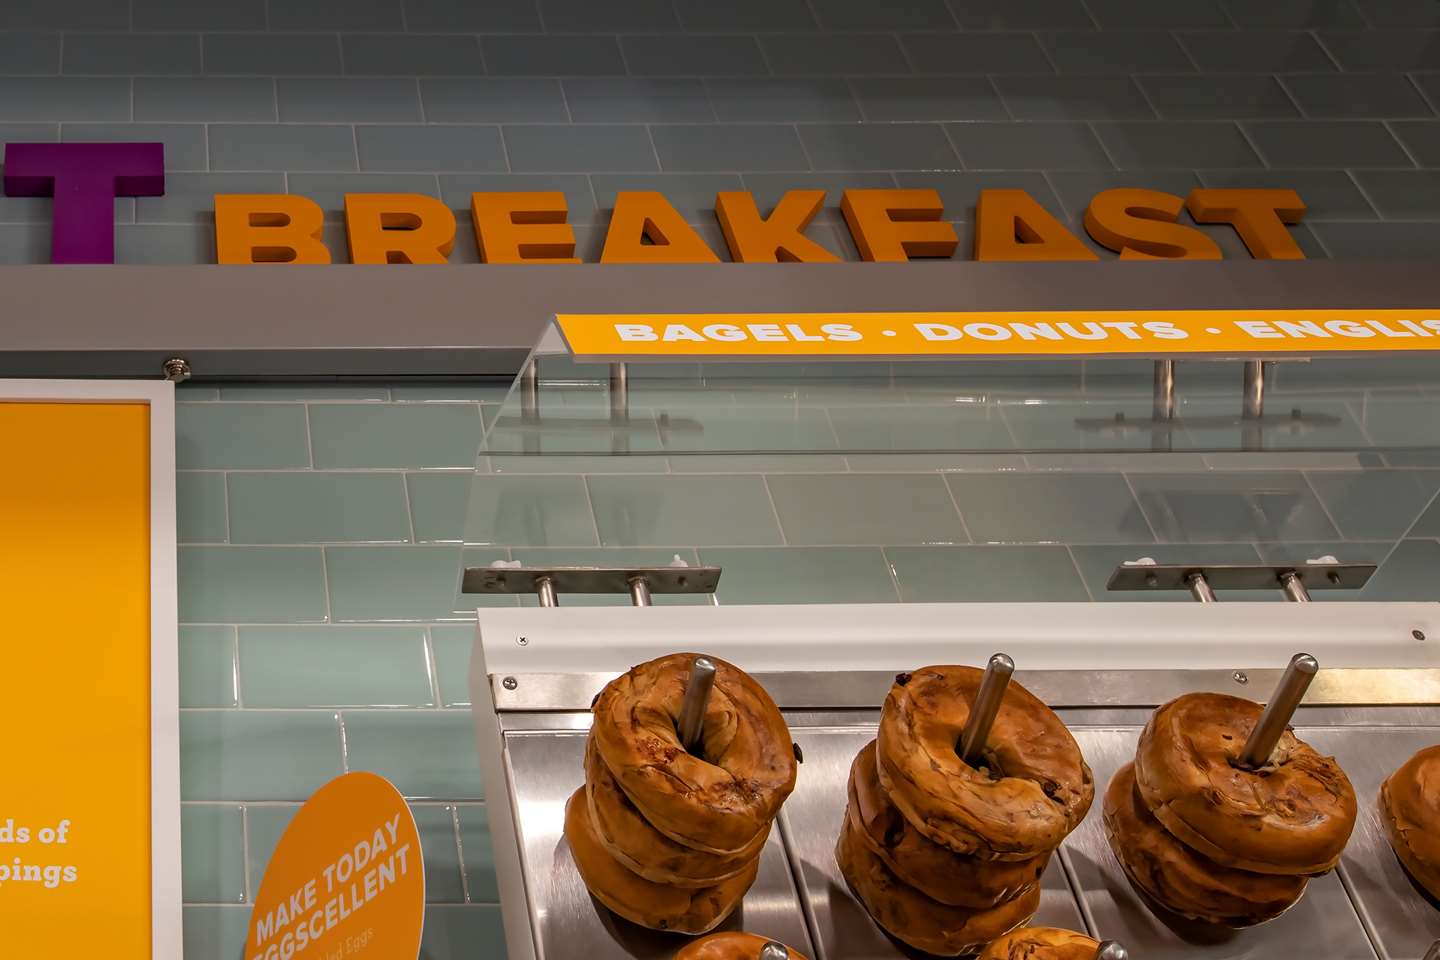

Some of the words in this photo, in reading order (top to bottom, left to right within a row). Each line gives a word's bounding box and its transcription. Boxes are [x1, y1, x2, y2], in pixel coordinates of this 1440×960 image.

[213, 187, 1307, 266] BREAKFAST
[614, 323, 864, 342] BAGELS
[913, 321, 1189, 341] DONUTS
[37, 819, 71, 844] of
[255, 878, 317, 947] MAKE
[322, 812, 402, 894] TODAY
